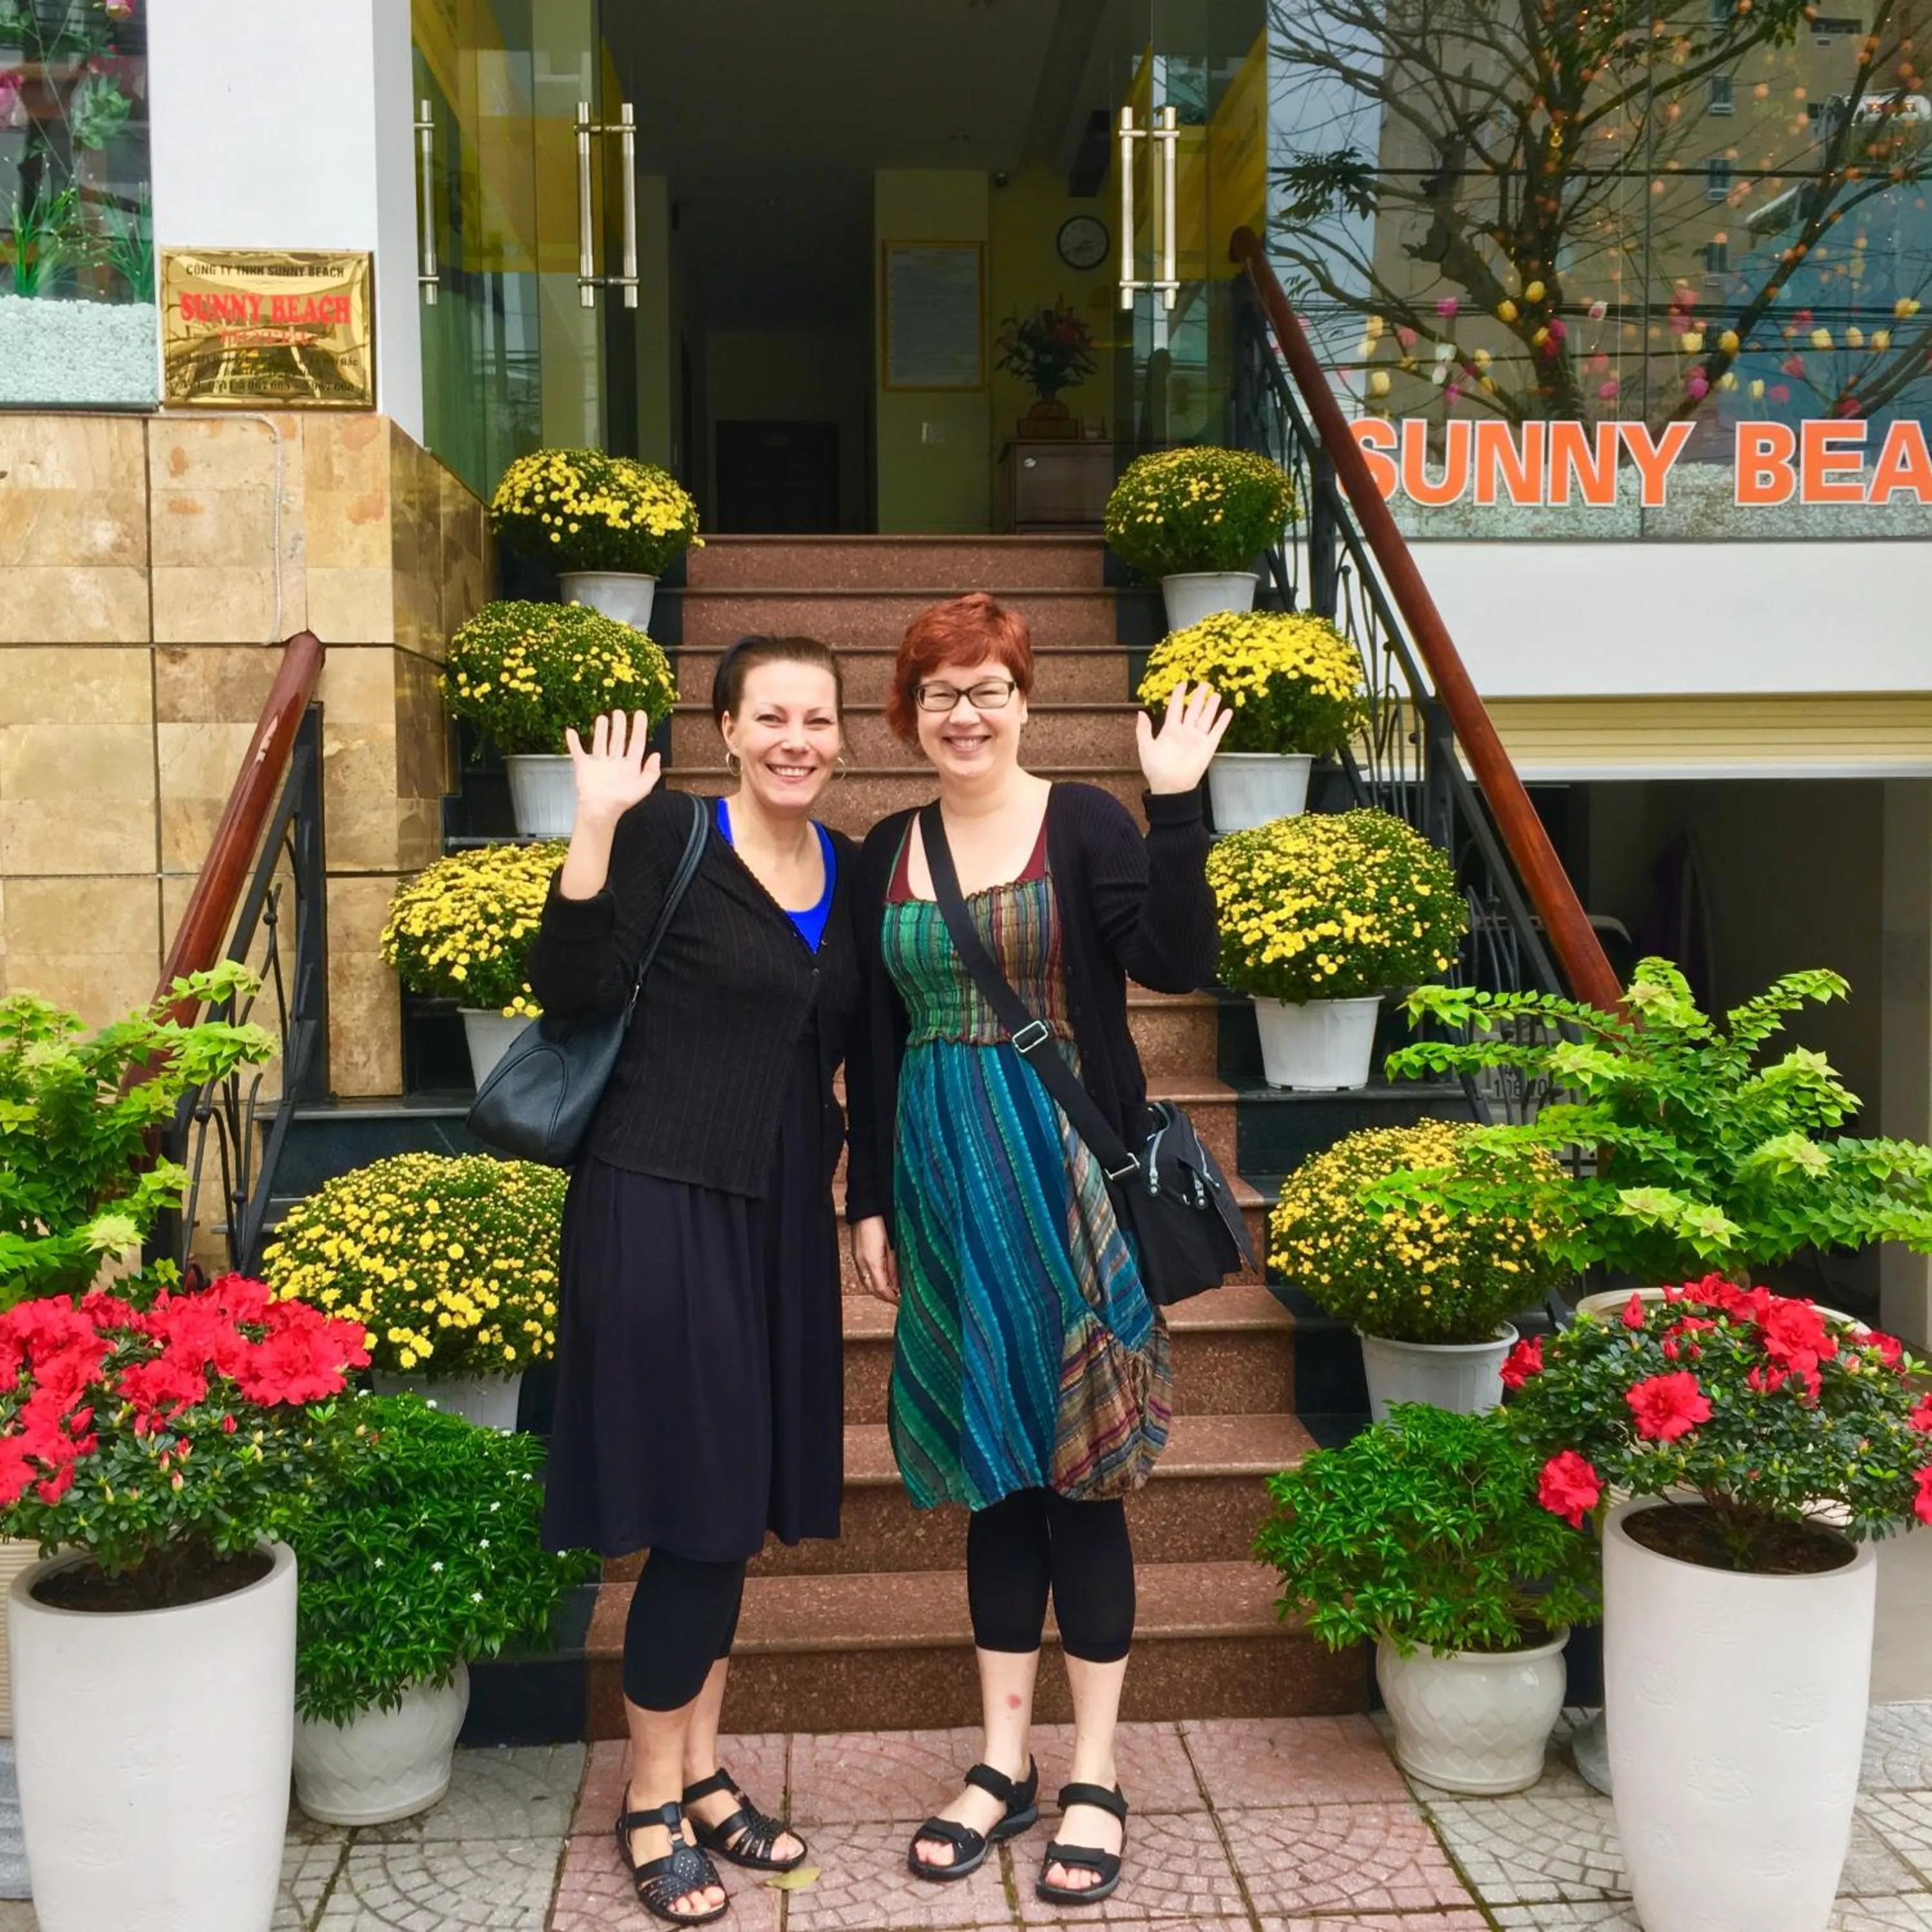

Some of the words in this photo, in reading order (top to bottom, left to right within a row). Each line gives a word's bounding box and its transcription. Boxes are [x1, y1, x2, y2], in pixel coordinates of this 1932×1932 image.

[220, 264, 232, 276] TY
[267, 265, 303, 276] SUNNY
[308, 265, 344, 277] BEACH
[180, 292, 262, 323] SUNNY
[270, 294, 350, 324] BEACH
[1336, 418, 1693, 506] SUNNY
[1734, 419, 1932, 507] BEA
